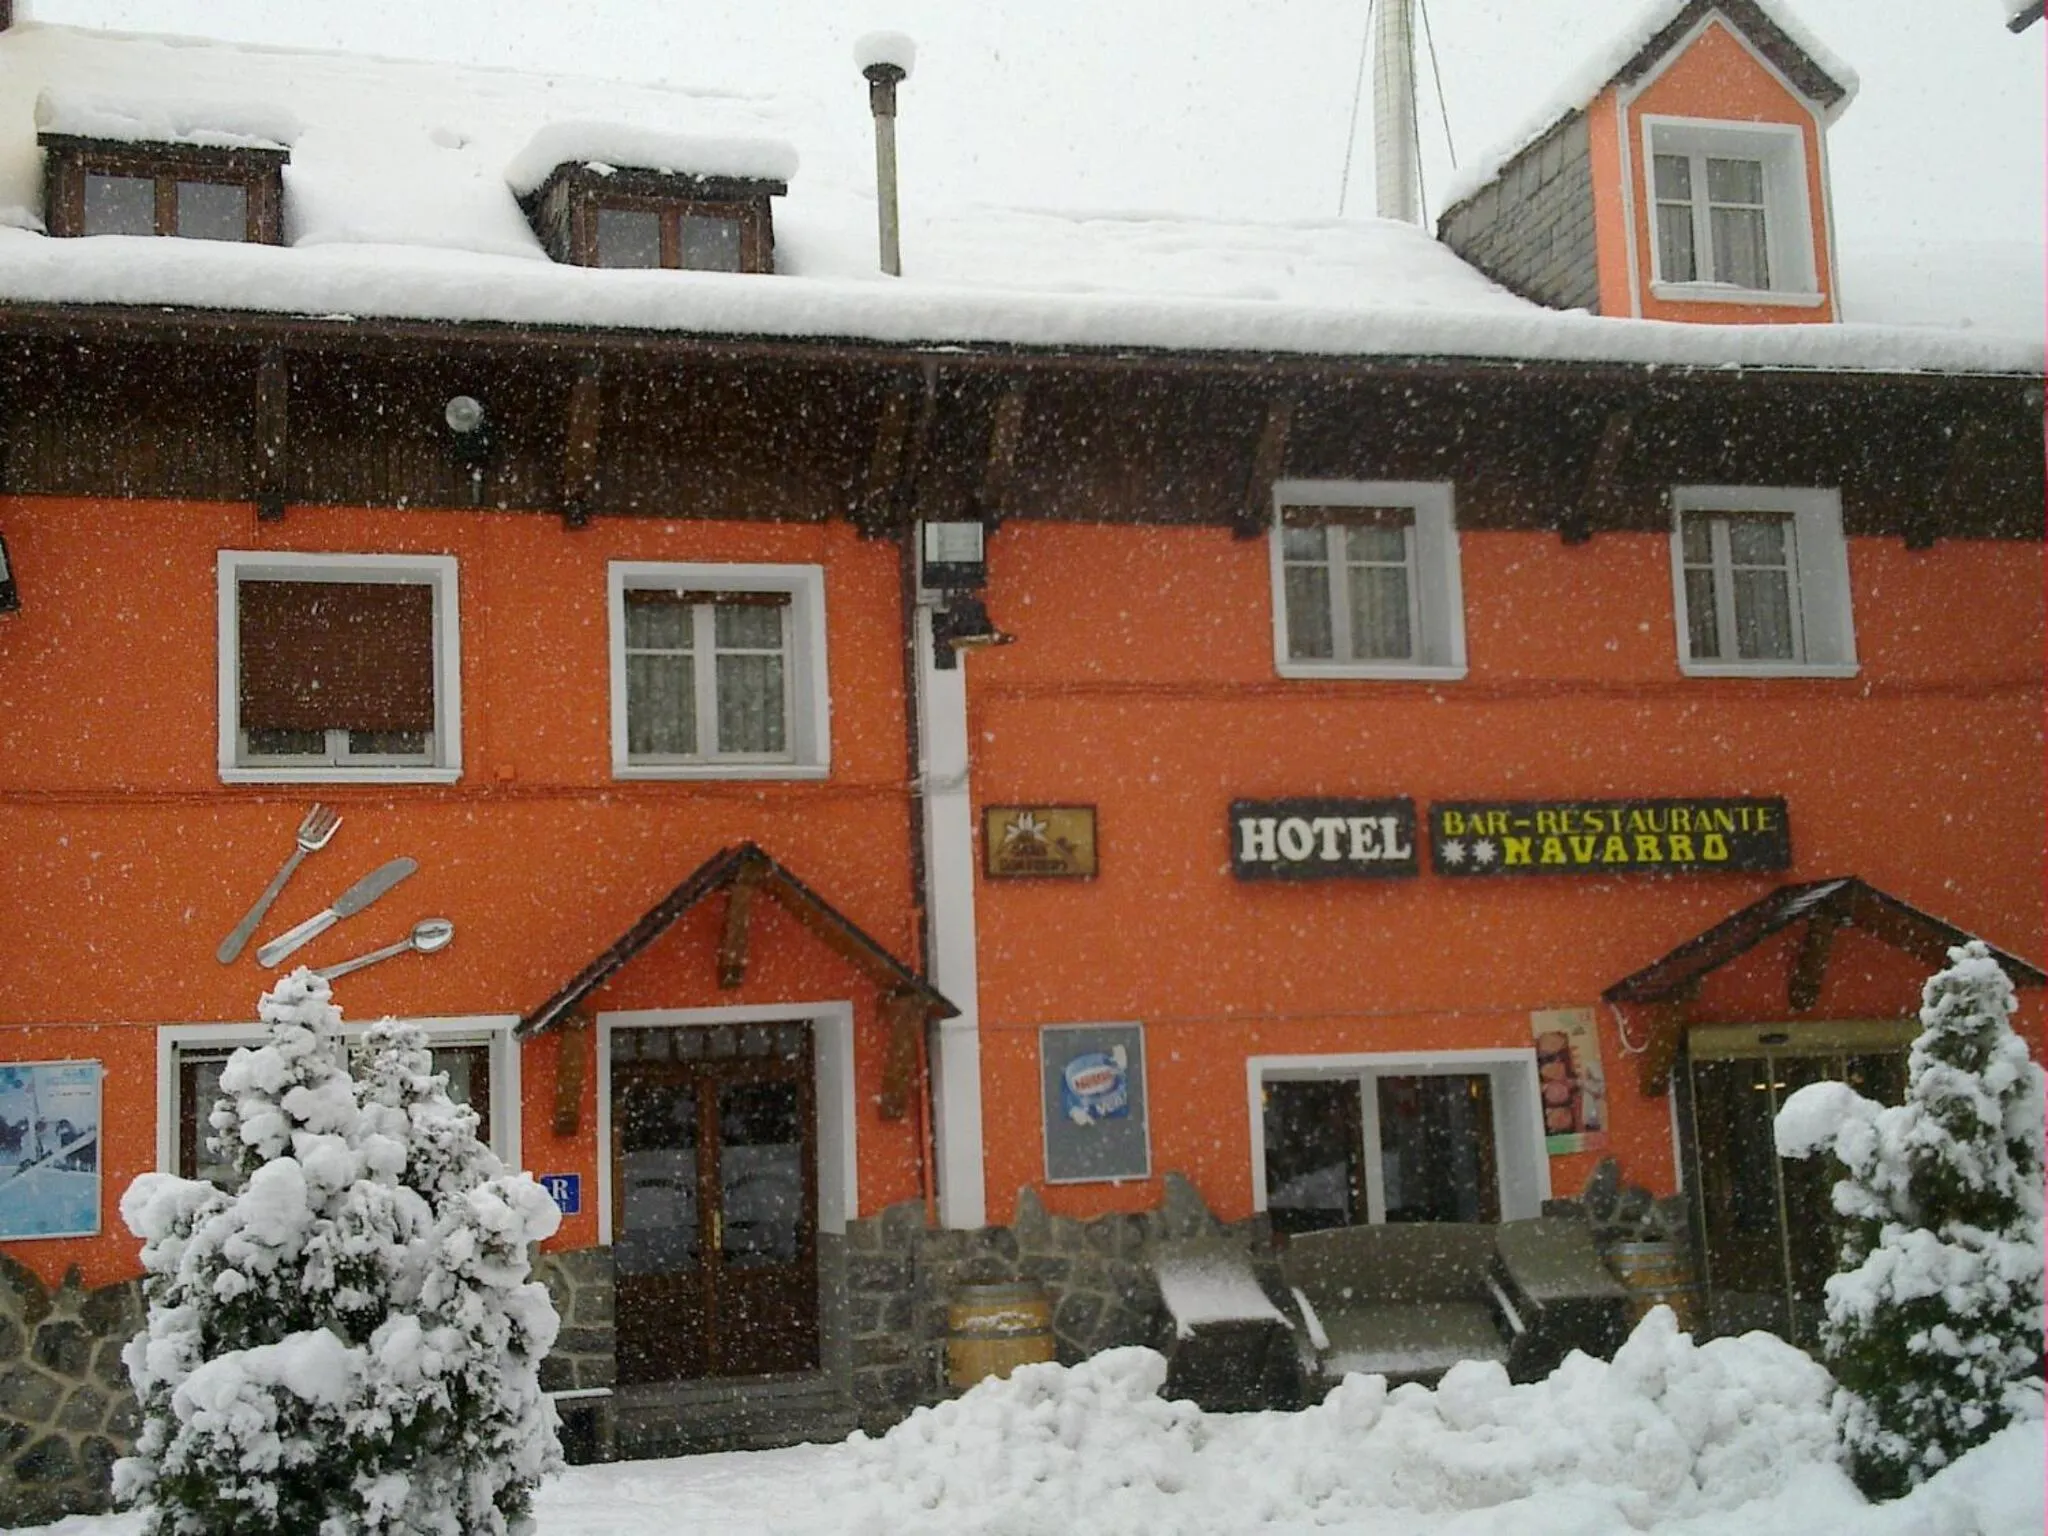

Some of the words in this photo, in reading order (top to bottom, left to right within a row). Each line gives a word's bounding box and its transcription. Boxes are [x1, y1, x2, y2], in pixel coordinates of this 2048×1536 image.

[1442, 807, 1778, 836] BAR-RESTAURANTE
[1238, 816, 1412, 861] HOTEL
[1502, 833, 1729, 866] NAVARRO
[552, 1178, 569, 1200] R
